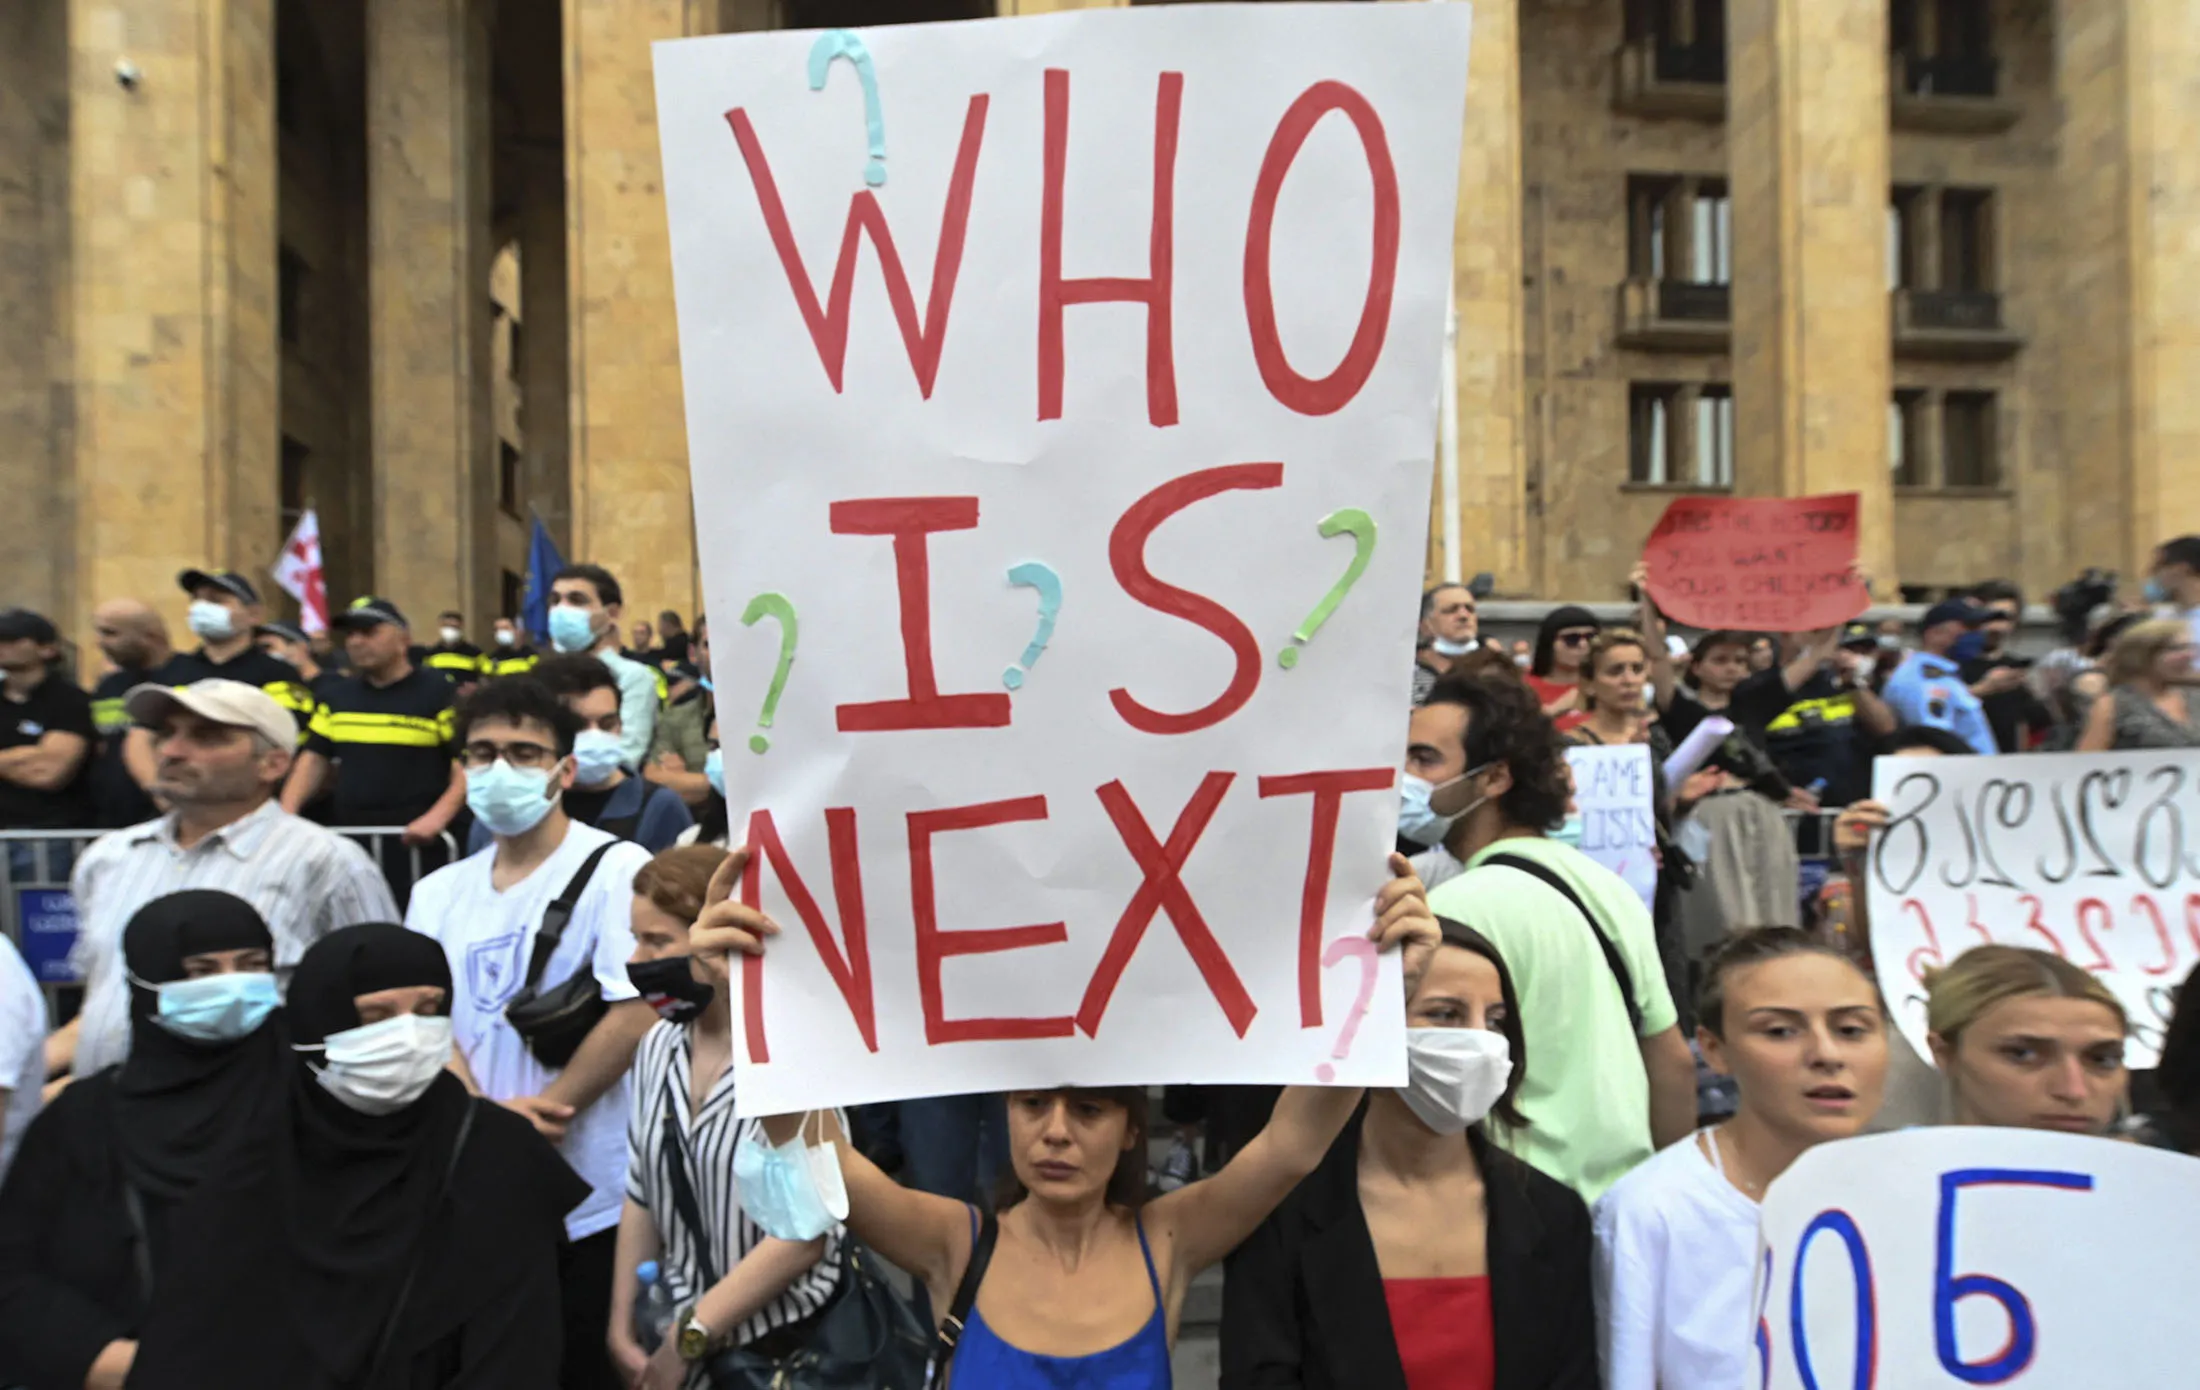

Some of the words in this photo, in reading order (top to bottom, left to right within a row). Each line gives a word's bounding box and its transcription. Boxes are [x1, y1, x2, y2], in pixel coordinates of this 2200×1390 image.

[723, 66, 1401, 428] WHO
[828, 462, 1284, 735] IS
[1731, 541, 1808, 568] WANT
[740, 767, 1396, 1064] NEXT
